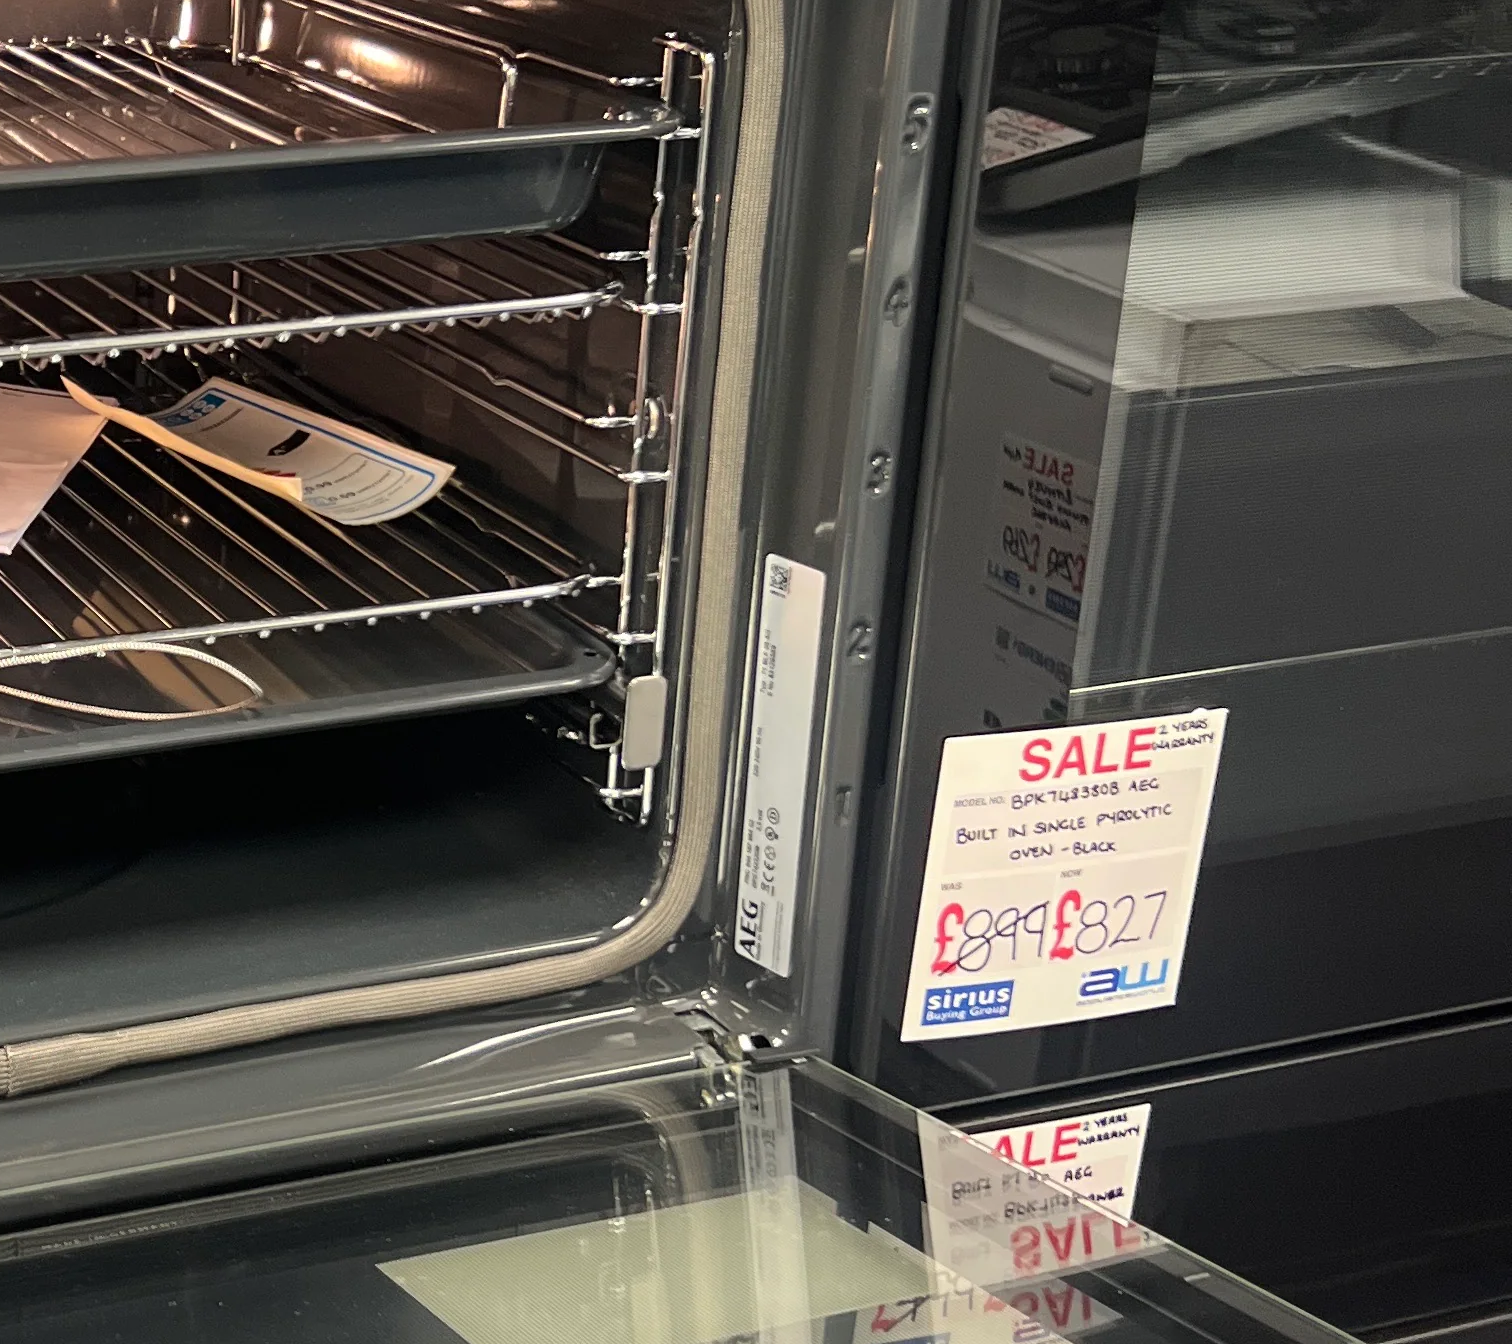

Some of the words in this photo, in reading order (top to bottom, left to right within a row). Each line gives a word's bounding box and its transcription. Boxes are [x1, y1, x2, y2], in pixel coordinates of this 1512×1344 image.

[1171, 717, 1209, 733] YEARS
[1018, 726, 1157, 783] SALE
[1128, 777, 1160, 792] AEG
[955, 827, 998, 844] BUILT
[1007, 824, 1027, 838] IN
[1033, 816, 1086, 835] SINGLE
[1096, 803, 1173, 827] PYROLYTIC
[1009, 844, 1053, 861] OVEN
[738, 898, 759, 958] AEG
[1049, 889, 1168, 961] £827
[926, 985, 1012, 1011] sirius
[989, 1122, 1082, 1169] ALE
[1064, 1165, 1093, 1183] AEG
